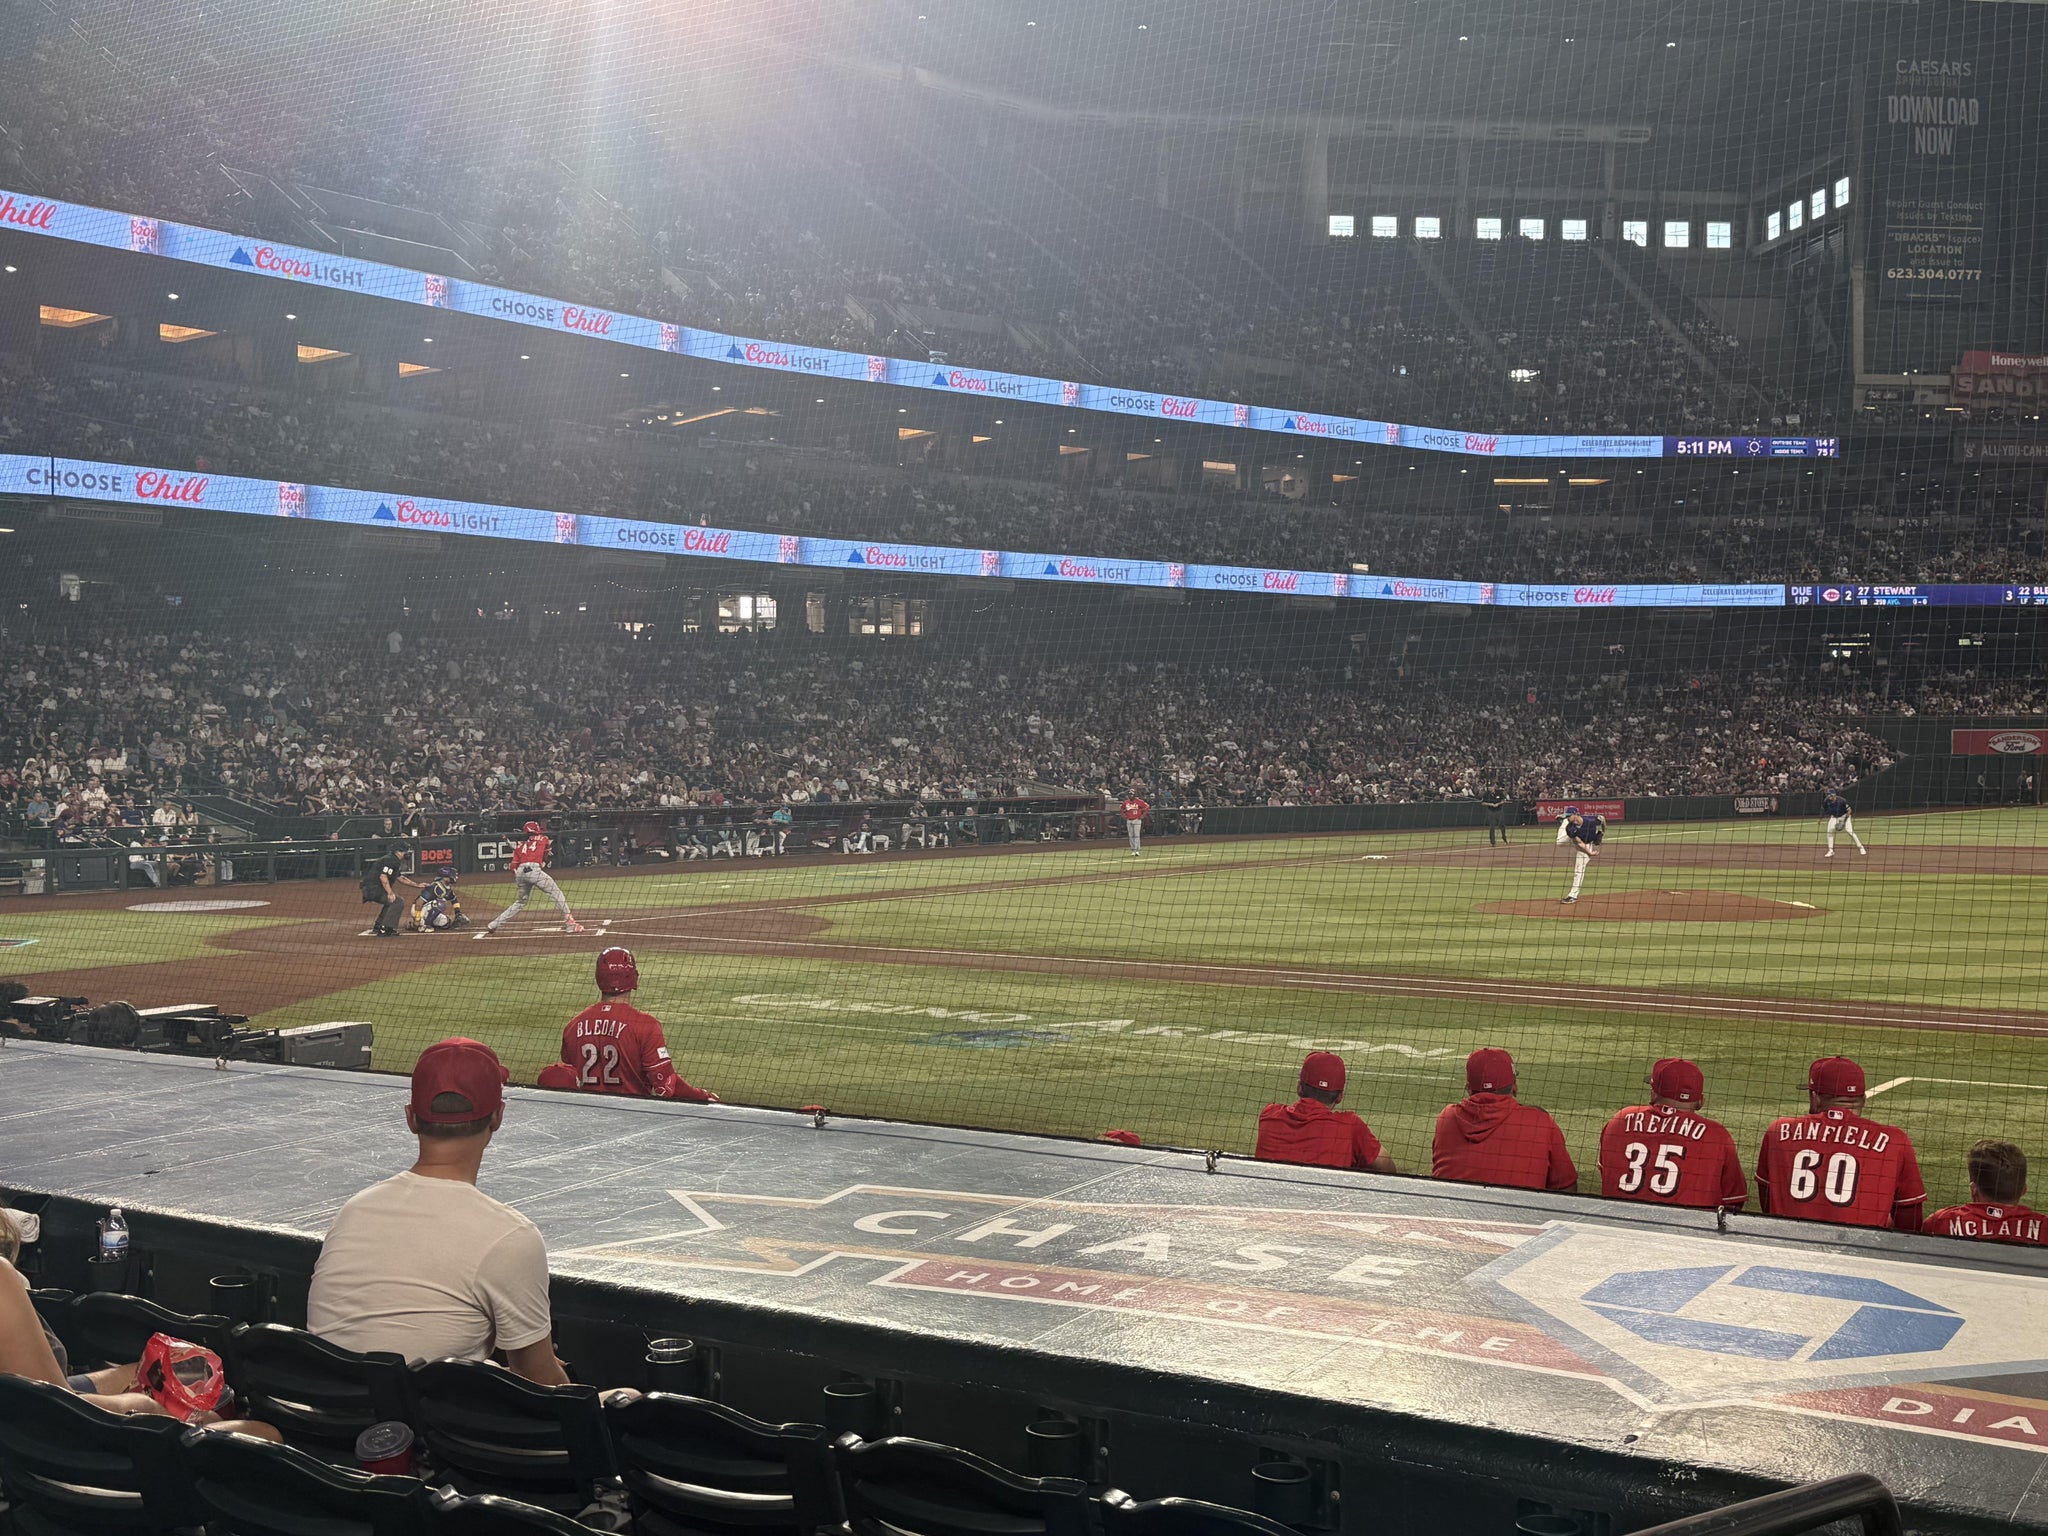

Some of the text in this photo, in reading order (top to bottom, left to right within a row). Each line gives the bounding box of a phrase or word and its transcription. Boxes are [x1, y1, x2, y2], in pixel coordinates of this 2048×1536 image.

[1896, 59, 1972, 77] CAESARS
[1888, 95, 1979, 126] DOWNLOAD
[1915, 126, 1953, 155] NOW
[0, 194, 57, 229] hill
[1947, 201, 1983, 210] Conduct
[1941, 212, 1973, 223] Texting
[1907, 245, 1962, 255] LOCATION
[255, 246, 364, 287] Coors LIGHT
[1887, 267, 1982, 280] 623.304.0777
[492, 297, 613, 335] CHOOSE Chill
[745, 342, 830, 372] Coors LIGHT
[949, 370, 1022, 396] Coors LIGHT
[1111, 396, 1200, 418] CHOOSE Chill
[1296, 415, 1354, 436] Coors LIGHT
[1423, 434, 1499, 453] CHOOSE Chill
[1677, 441, 1732, 454] 5:11 PM
[1815, 439, 1835, 447] 114 F
[1817, 448, 1829, 457] 75
[26, 468, 209, 503] CHOOSE Chill
[397, 500, 499, 532] Coors LIGHT
[617, 528, 732, 554] CHOOSE Chill
[865, 546, 946, 569] Coors LIGHT
[1059, 559, 1130, 580] Coors LIGHT
[1214, 571, 1300, 591] CHOOSE Chill
[1393, 581, 1449, 599] Coors LIGHT
[1791, 586, 1812, 596] DUE
[1858, 586, 1917, 596] 27 STEWART
[2018, 586, 2030, 595] 22
[1519, 587, 1617, 604] CHOOSE Chill
[1795, 596, 1809, 605] UP
[1845, 590, 1852, 600] 2
[2005, 590, 2013, 601] 3
[421, 848, 453, 861] BOB'S
[521, 841, 537, 854] 44
[576, 1019, 627, 1039] BLEDAY
[1046, 1019, 1468, 1059] ARIZON
[581, 1043, 621, 1085] 22
[1624, 1112, 1707, 1141] TREVINO
[1780, 1121, 1890, 1153] BANFIELD
[1618, 1141, 1687, 1196] 35
[1789, 1149, 1860, 1207] 60
[1949, 1215, 2042, 1241] MCLAIN
[852, 1210, 1430, 1287] CHASE
[945, 1270, 1519, 1352] HOME OF THE
[1881, 1396, 2039, 1436] DIA
